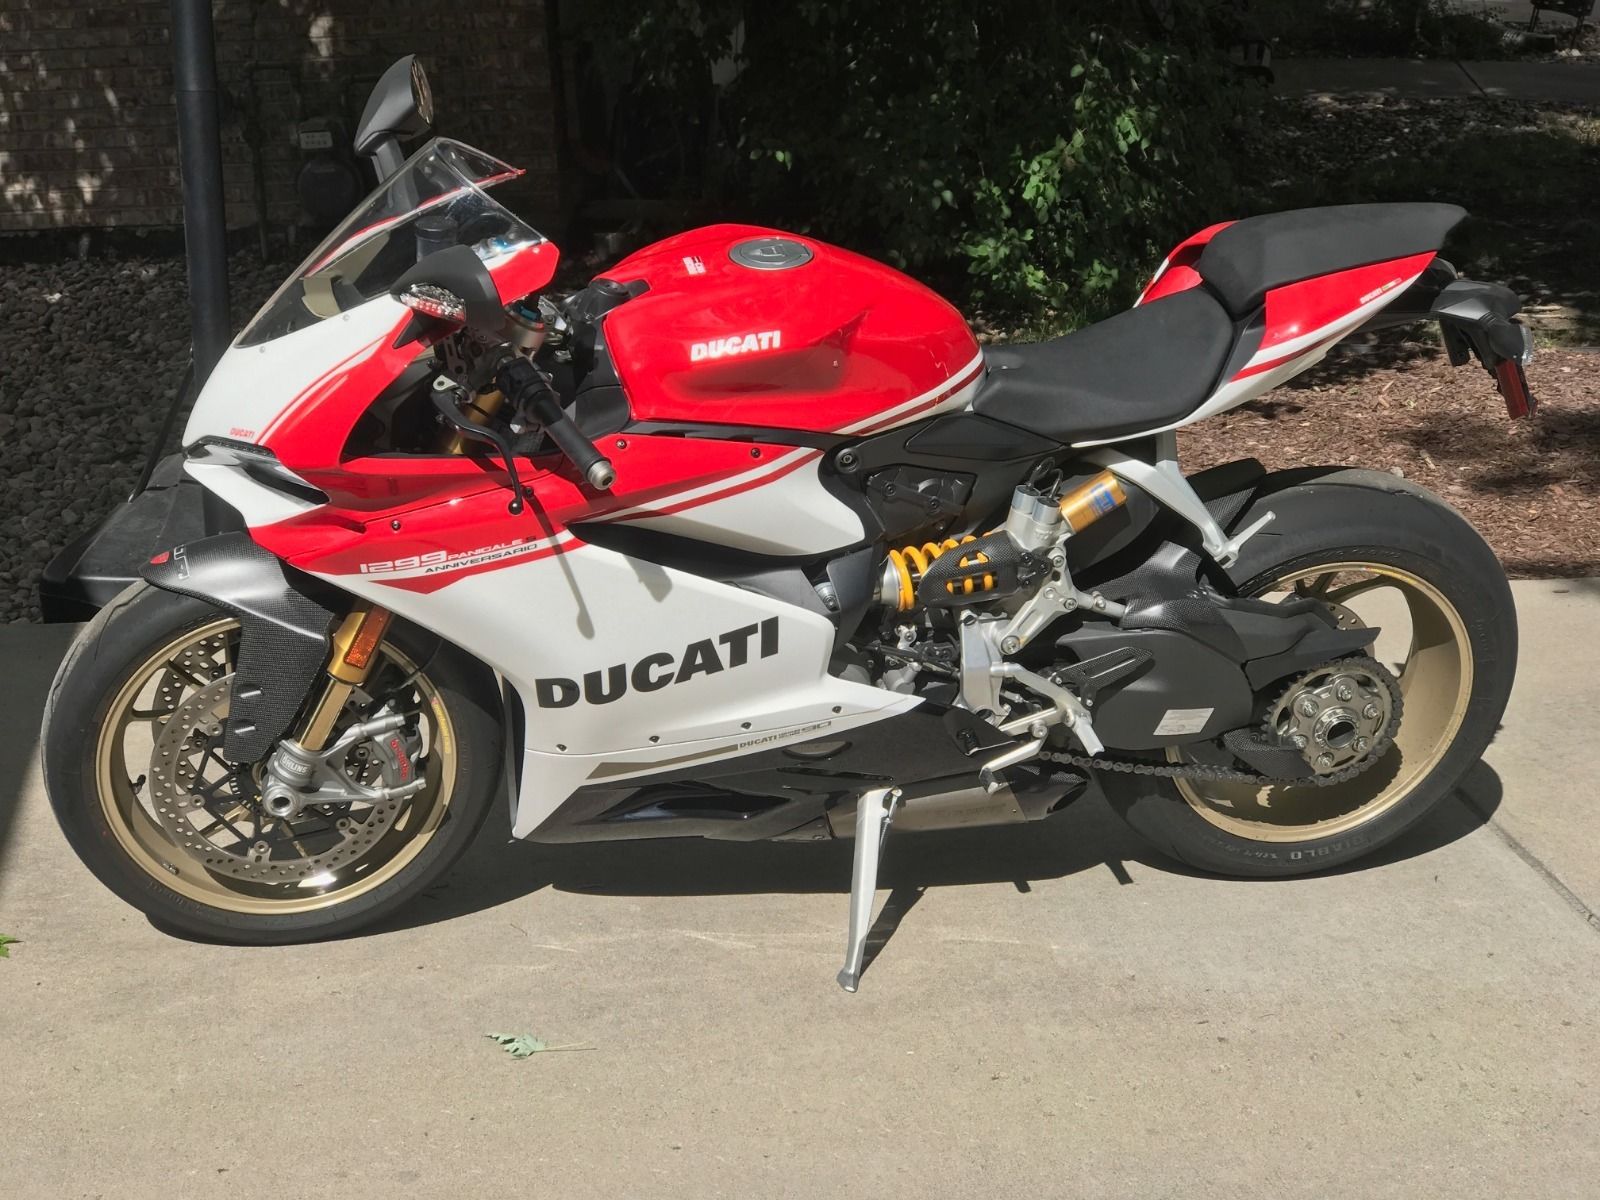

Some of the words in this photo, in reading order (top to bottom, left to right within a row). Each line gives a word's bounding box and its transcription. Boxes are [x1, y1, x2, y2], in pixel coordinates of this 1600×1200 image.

[690, 330, 781, 362] DUCATI
[230, 427, 256, 439] DUCATI
[359, 550, 447, 574] 1299
[448, 538, 523, 560] PANIGALE
[425, 543, 537, 574] ANNIVERSARIO
[535, 616, 779, 709] DUCATI
[740, 735, 777, 748] DUCATI
